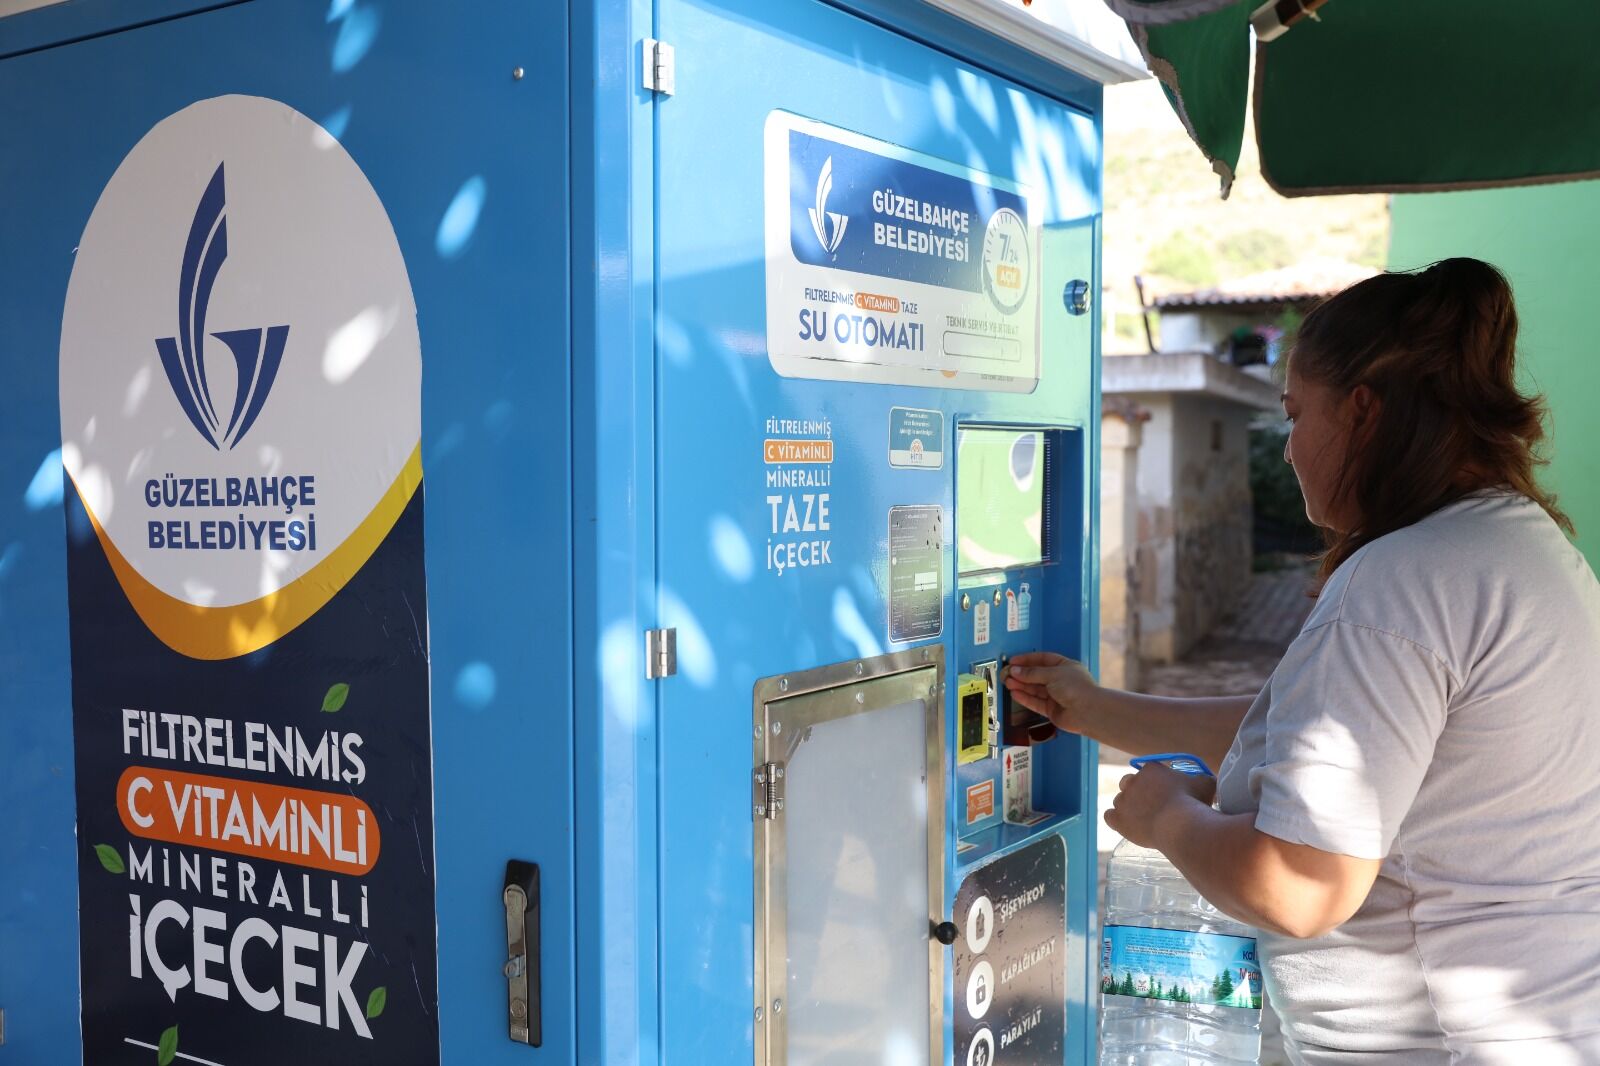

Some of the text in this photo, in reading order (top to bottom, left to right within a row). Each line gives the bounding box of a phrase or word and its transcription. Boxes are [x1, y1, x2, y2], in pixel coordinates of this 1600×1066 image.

[872, 188, 969, 236] GÜZELBAHÇE
[874, 222, 969, 263] BELEDİYESİ
[856, 294, 862, 307] C
[901, 301, 918, 314] TAZE
[799, 308, 924, 351] SU OTOMATI
[766, 415, 832, 439] FİLTRELENMİŞ
[767, 441, 830, 460] C VİTAMİNLİ
[145, 473, 316, 514] GÜZELBAHÇE
[766, 464, 830, 488] MİNERALLİ
[148, 513, 317, 551] BELEDİYESİ
[767, 493, 830, 534] TAZE
[767, 538, 832, 577] İÇECEK
[127, 776, 367, 866] C VİTAMİNLİ
[129, 841, 369, 928] MİNERALLİ
[129, 893, 374, 1040] İÇECEK
